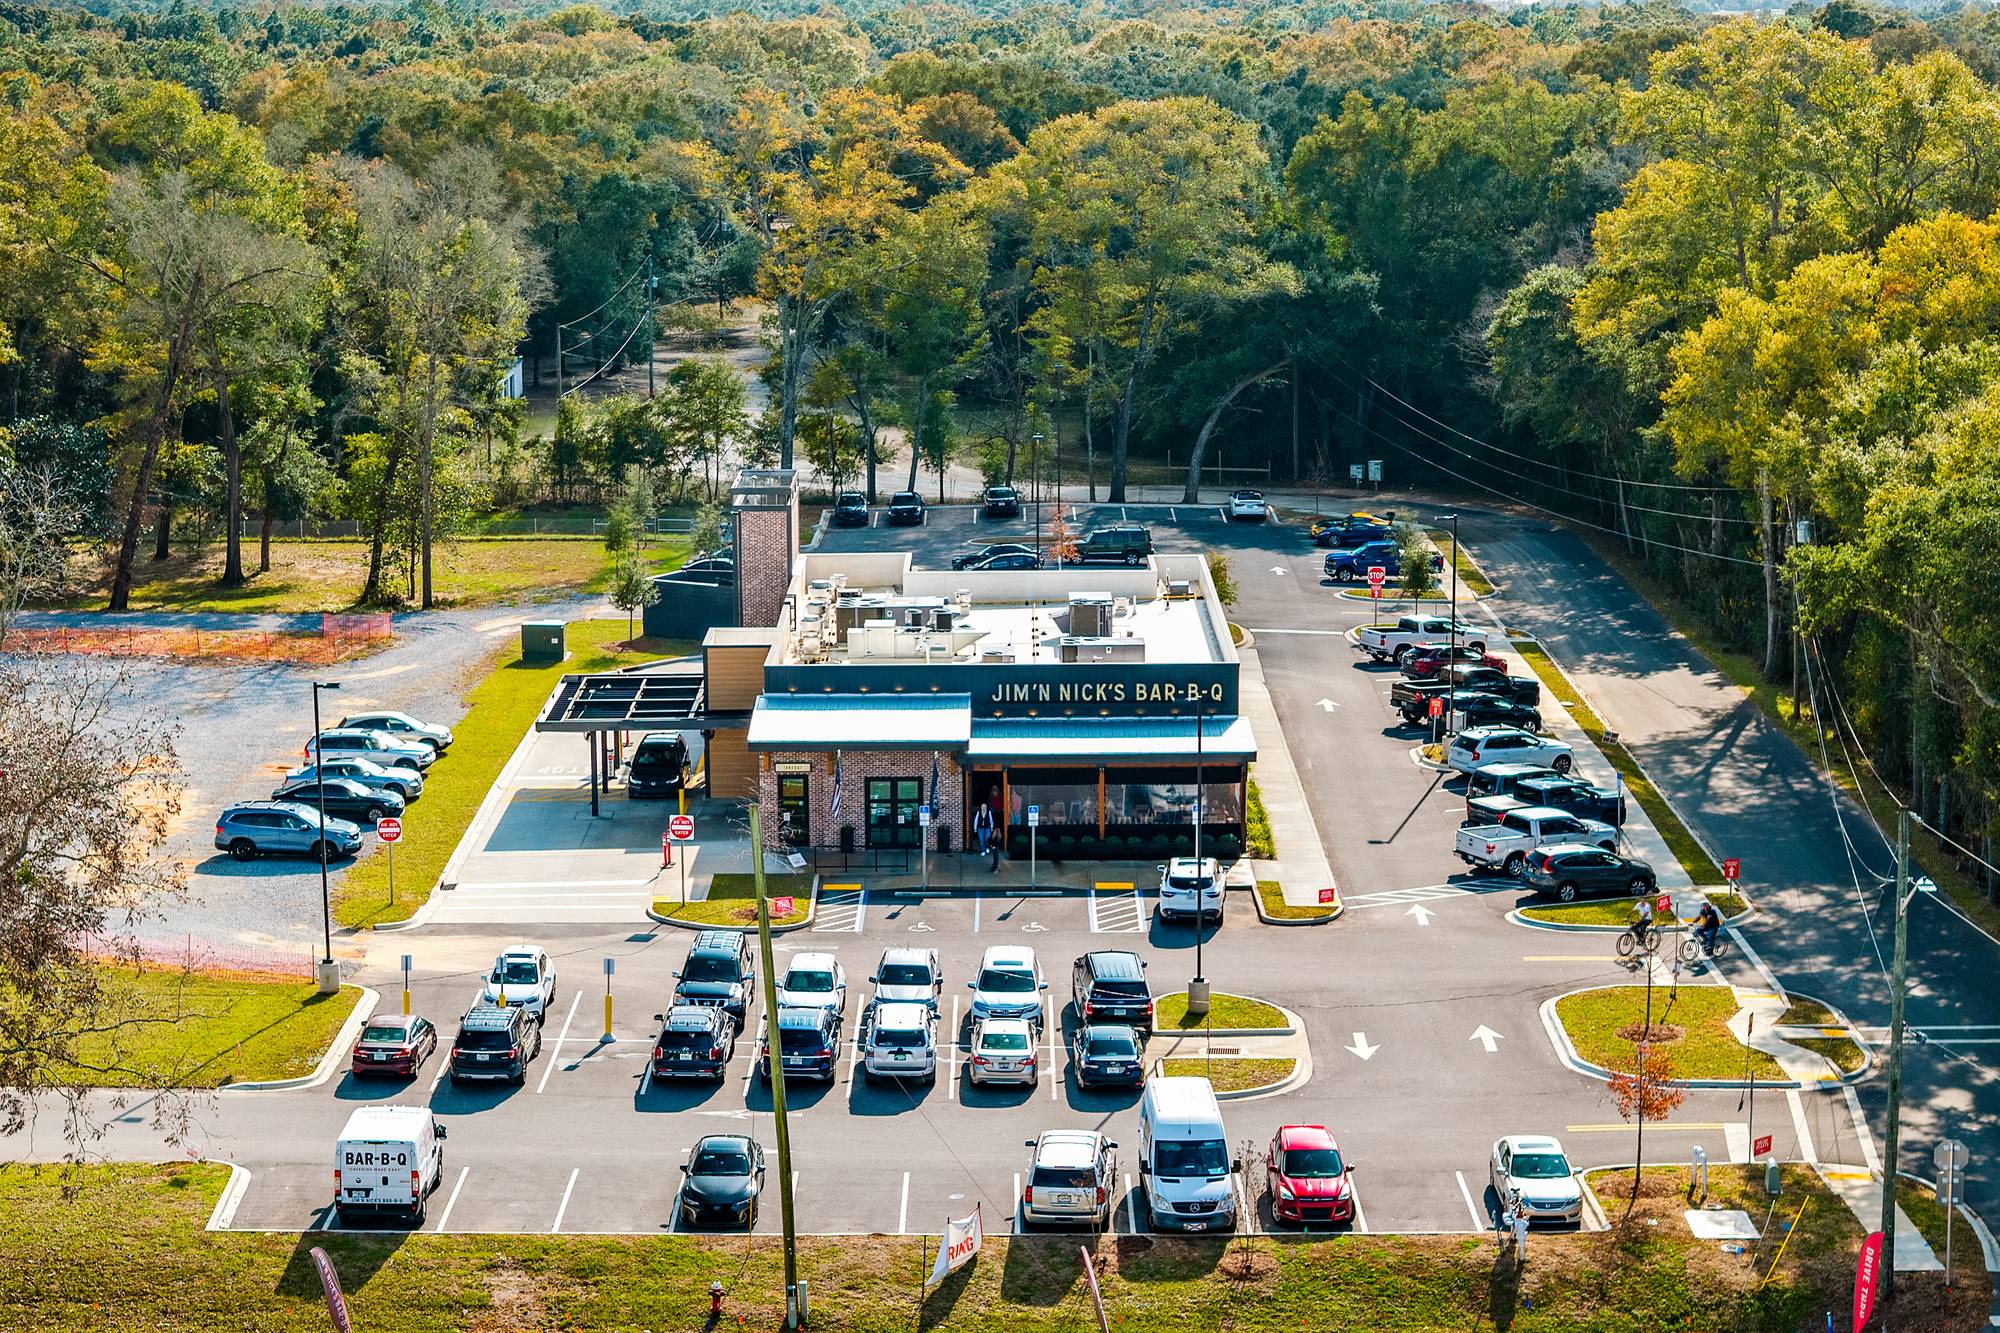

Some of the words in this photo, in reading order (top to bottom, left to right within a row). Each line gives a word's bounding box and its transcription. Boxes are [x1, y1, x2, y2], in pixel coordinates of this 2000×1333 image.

[1369, 572, 1384, 580] STOP
[992, 683, 1050, 702] JIM'N
[1059, 683, 1126, 702] NICK'S
[1136, 683, 1223, 702] BAR-B-Q
[345, 1152, 407, 1166] BAR-B-Q
[1862, 1246, 1875, 1284] DRIVE
[1859, 1287, 1868, 1319] THRU
